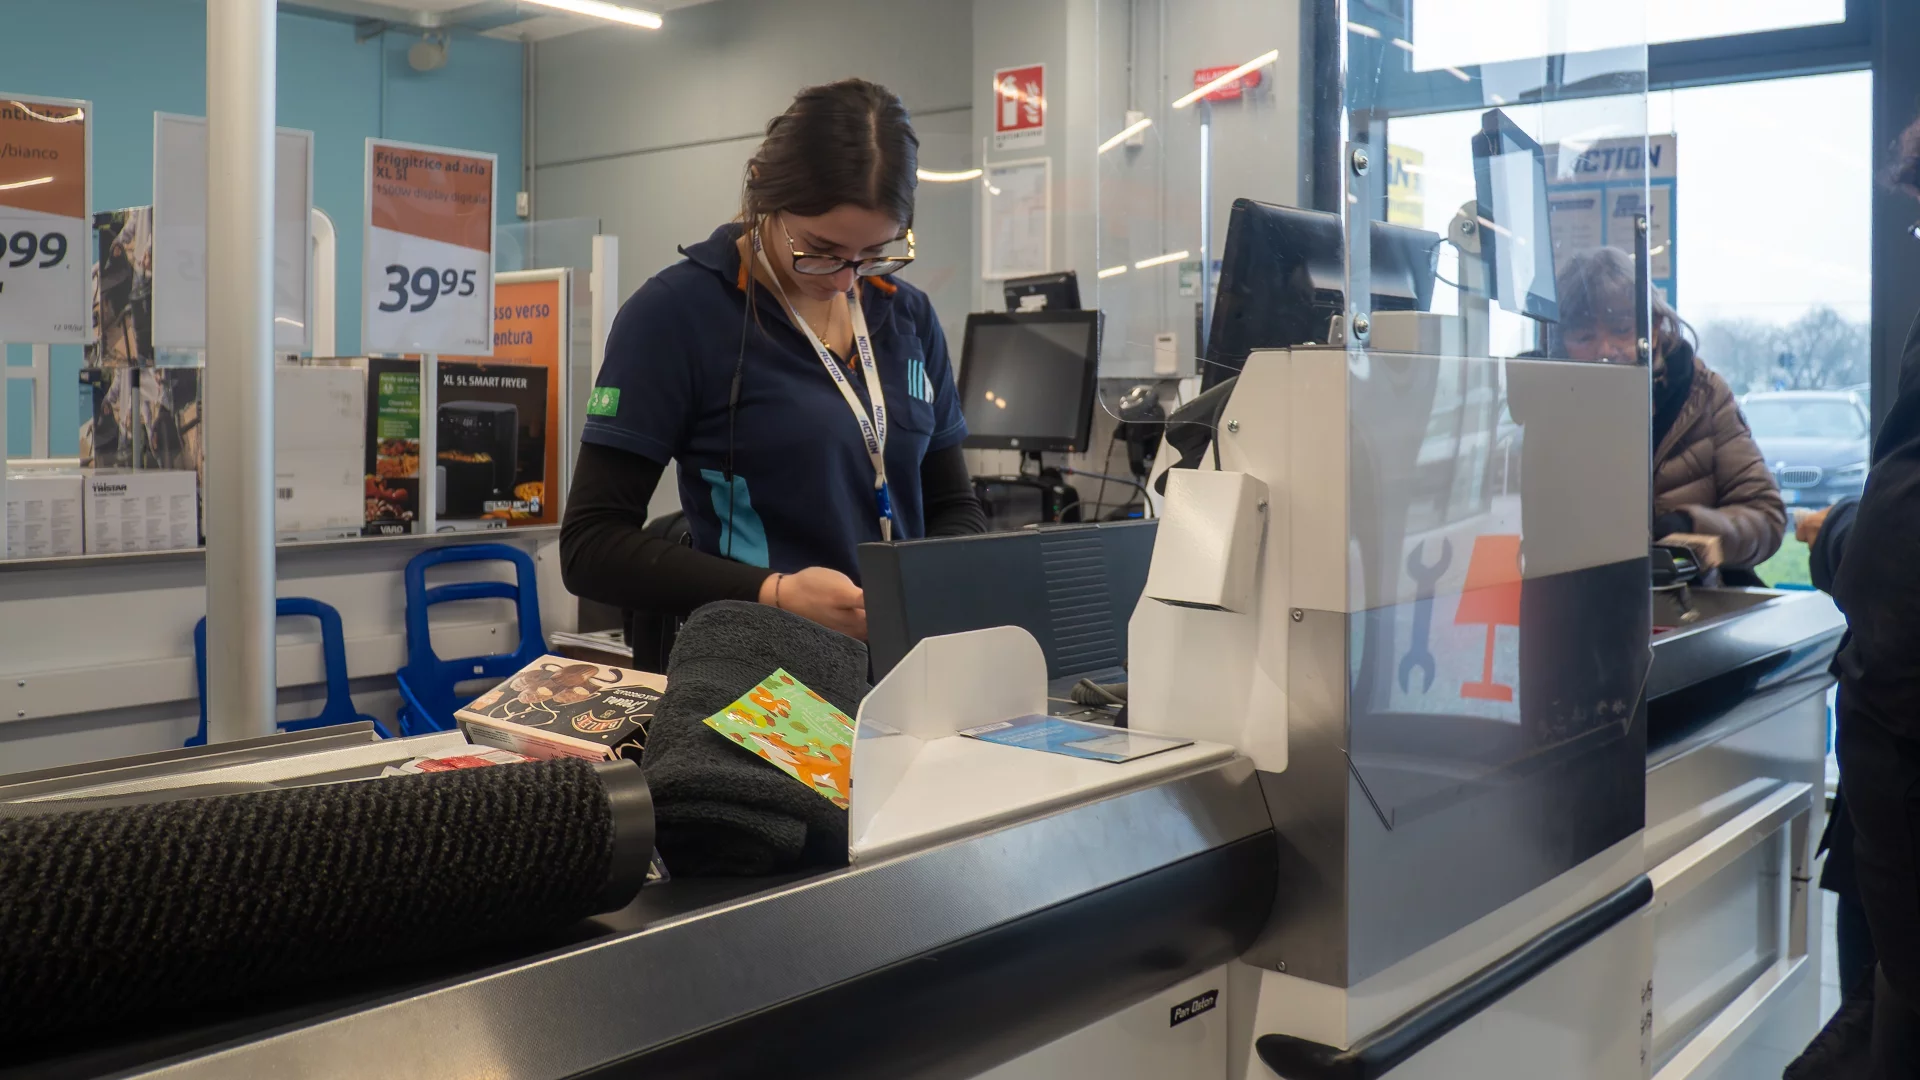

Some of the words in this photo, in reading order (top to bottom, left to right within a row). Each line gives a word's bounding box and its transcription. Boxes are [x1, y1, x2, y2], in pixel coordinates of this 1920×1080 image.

[0, 143, 58, 160] /bianco
[376, 152, 441, 171] Friggitrice
[445, 161, 459, 172] ad
[462, 163, 485, 175] aria
[376, 167, 392, 179] XL
[413, 189, 447, 202] display
[0, 230, 68, 269] 99
[515, 303, 550, 319] verso
[858, 335, 873, 369] ACTION
[820, 350, 844, 384] ACTION
[443, 374, 454, 386] XL
[469, 376, 499, 388] SMART
[501, 377, 528, 389] FRYER
[875, 405, 884, 441] ACTION
[860, 419, 879, 455] ACTION
[576, 713, 619, 731] BAILEYS
[1174, 1007, 1190, 1022] Pan
